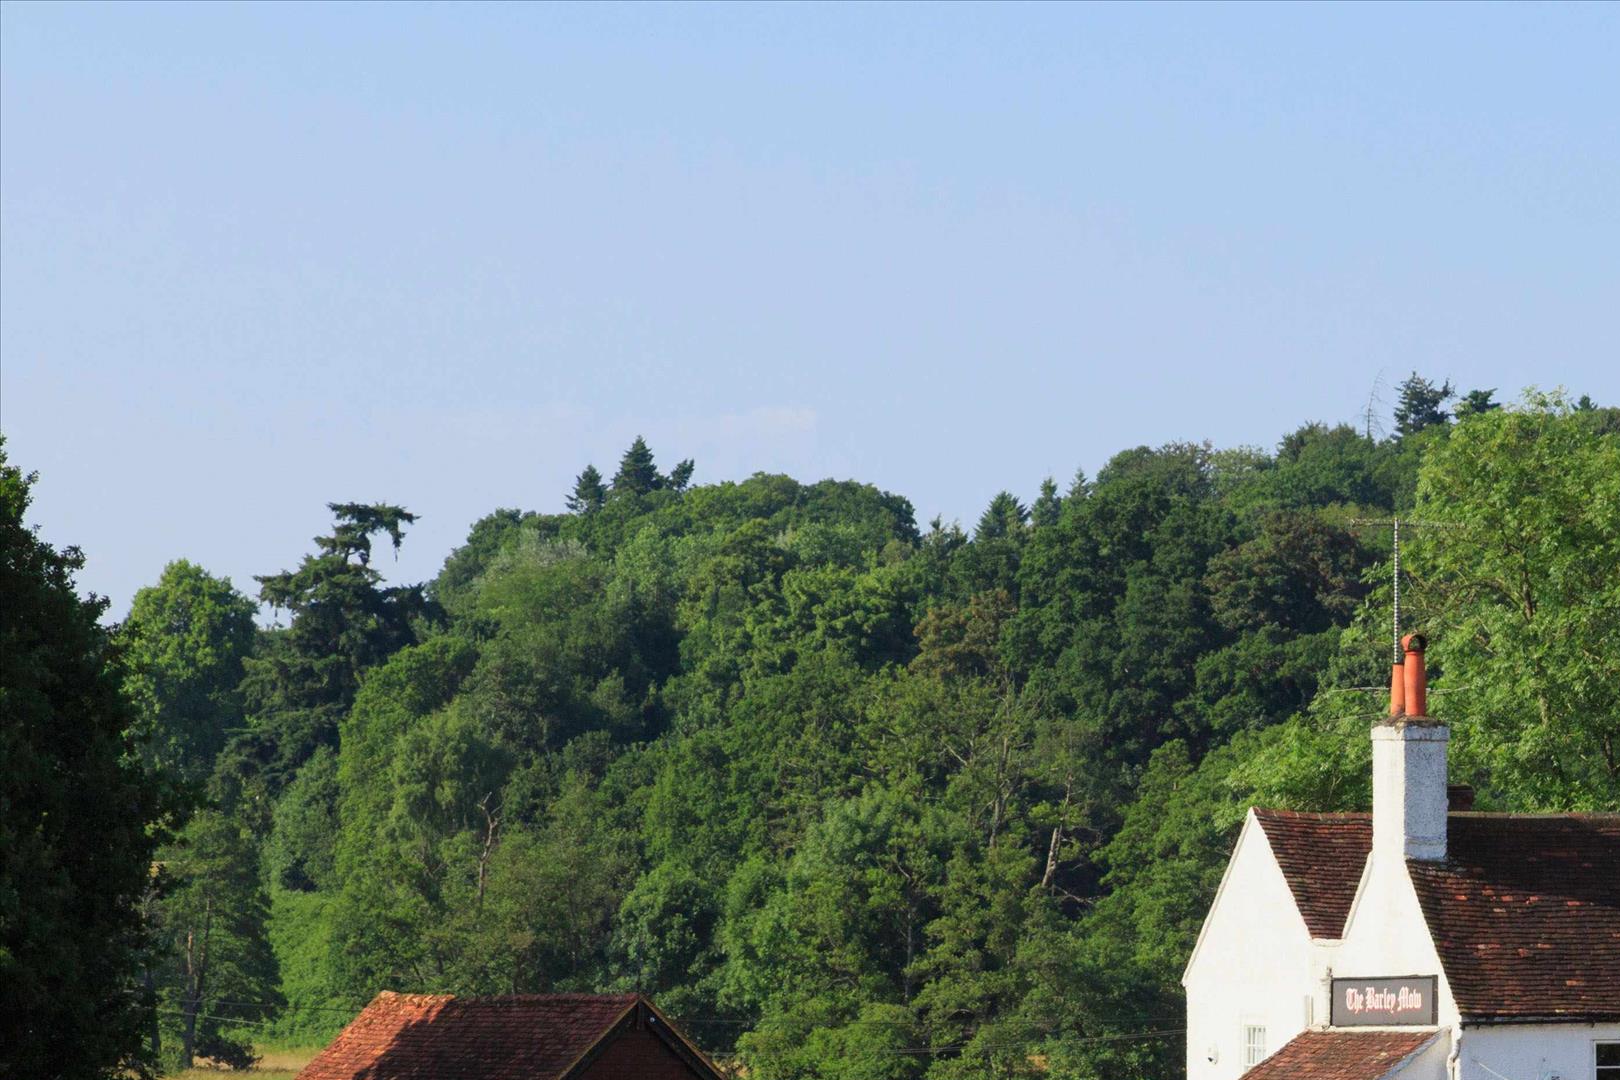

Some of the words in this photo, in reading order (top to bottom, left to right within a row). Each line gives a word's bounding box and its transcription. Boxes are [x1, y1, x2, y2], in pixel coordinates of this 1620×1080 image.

[1346, 987, 1363, 1014] The
[1365, 987, 1396, 1014] Barley
[1397, 986, 1422, 1011] Mow
